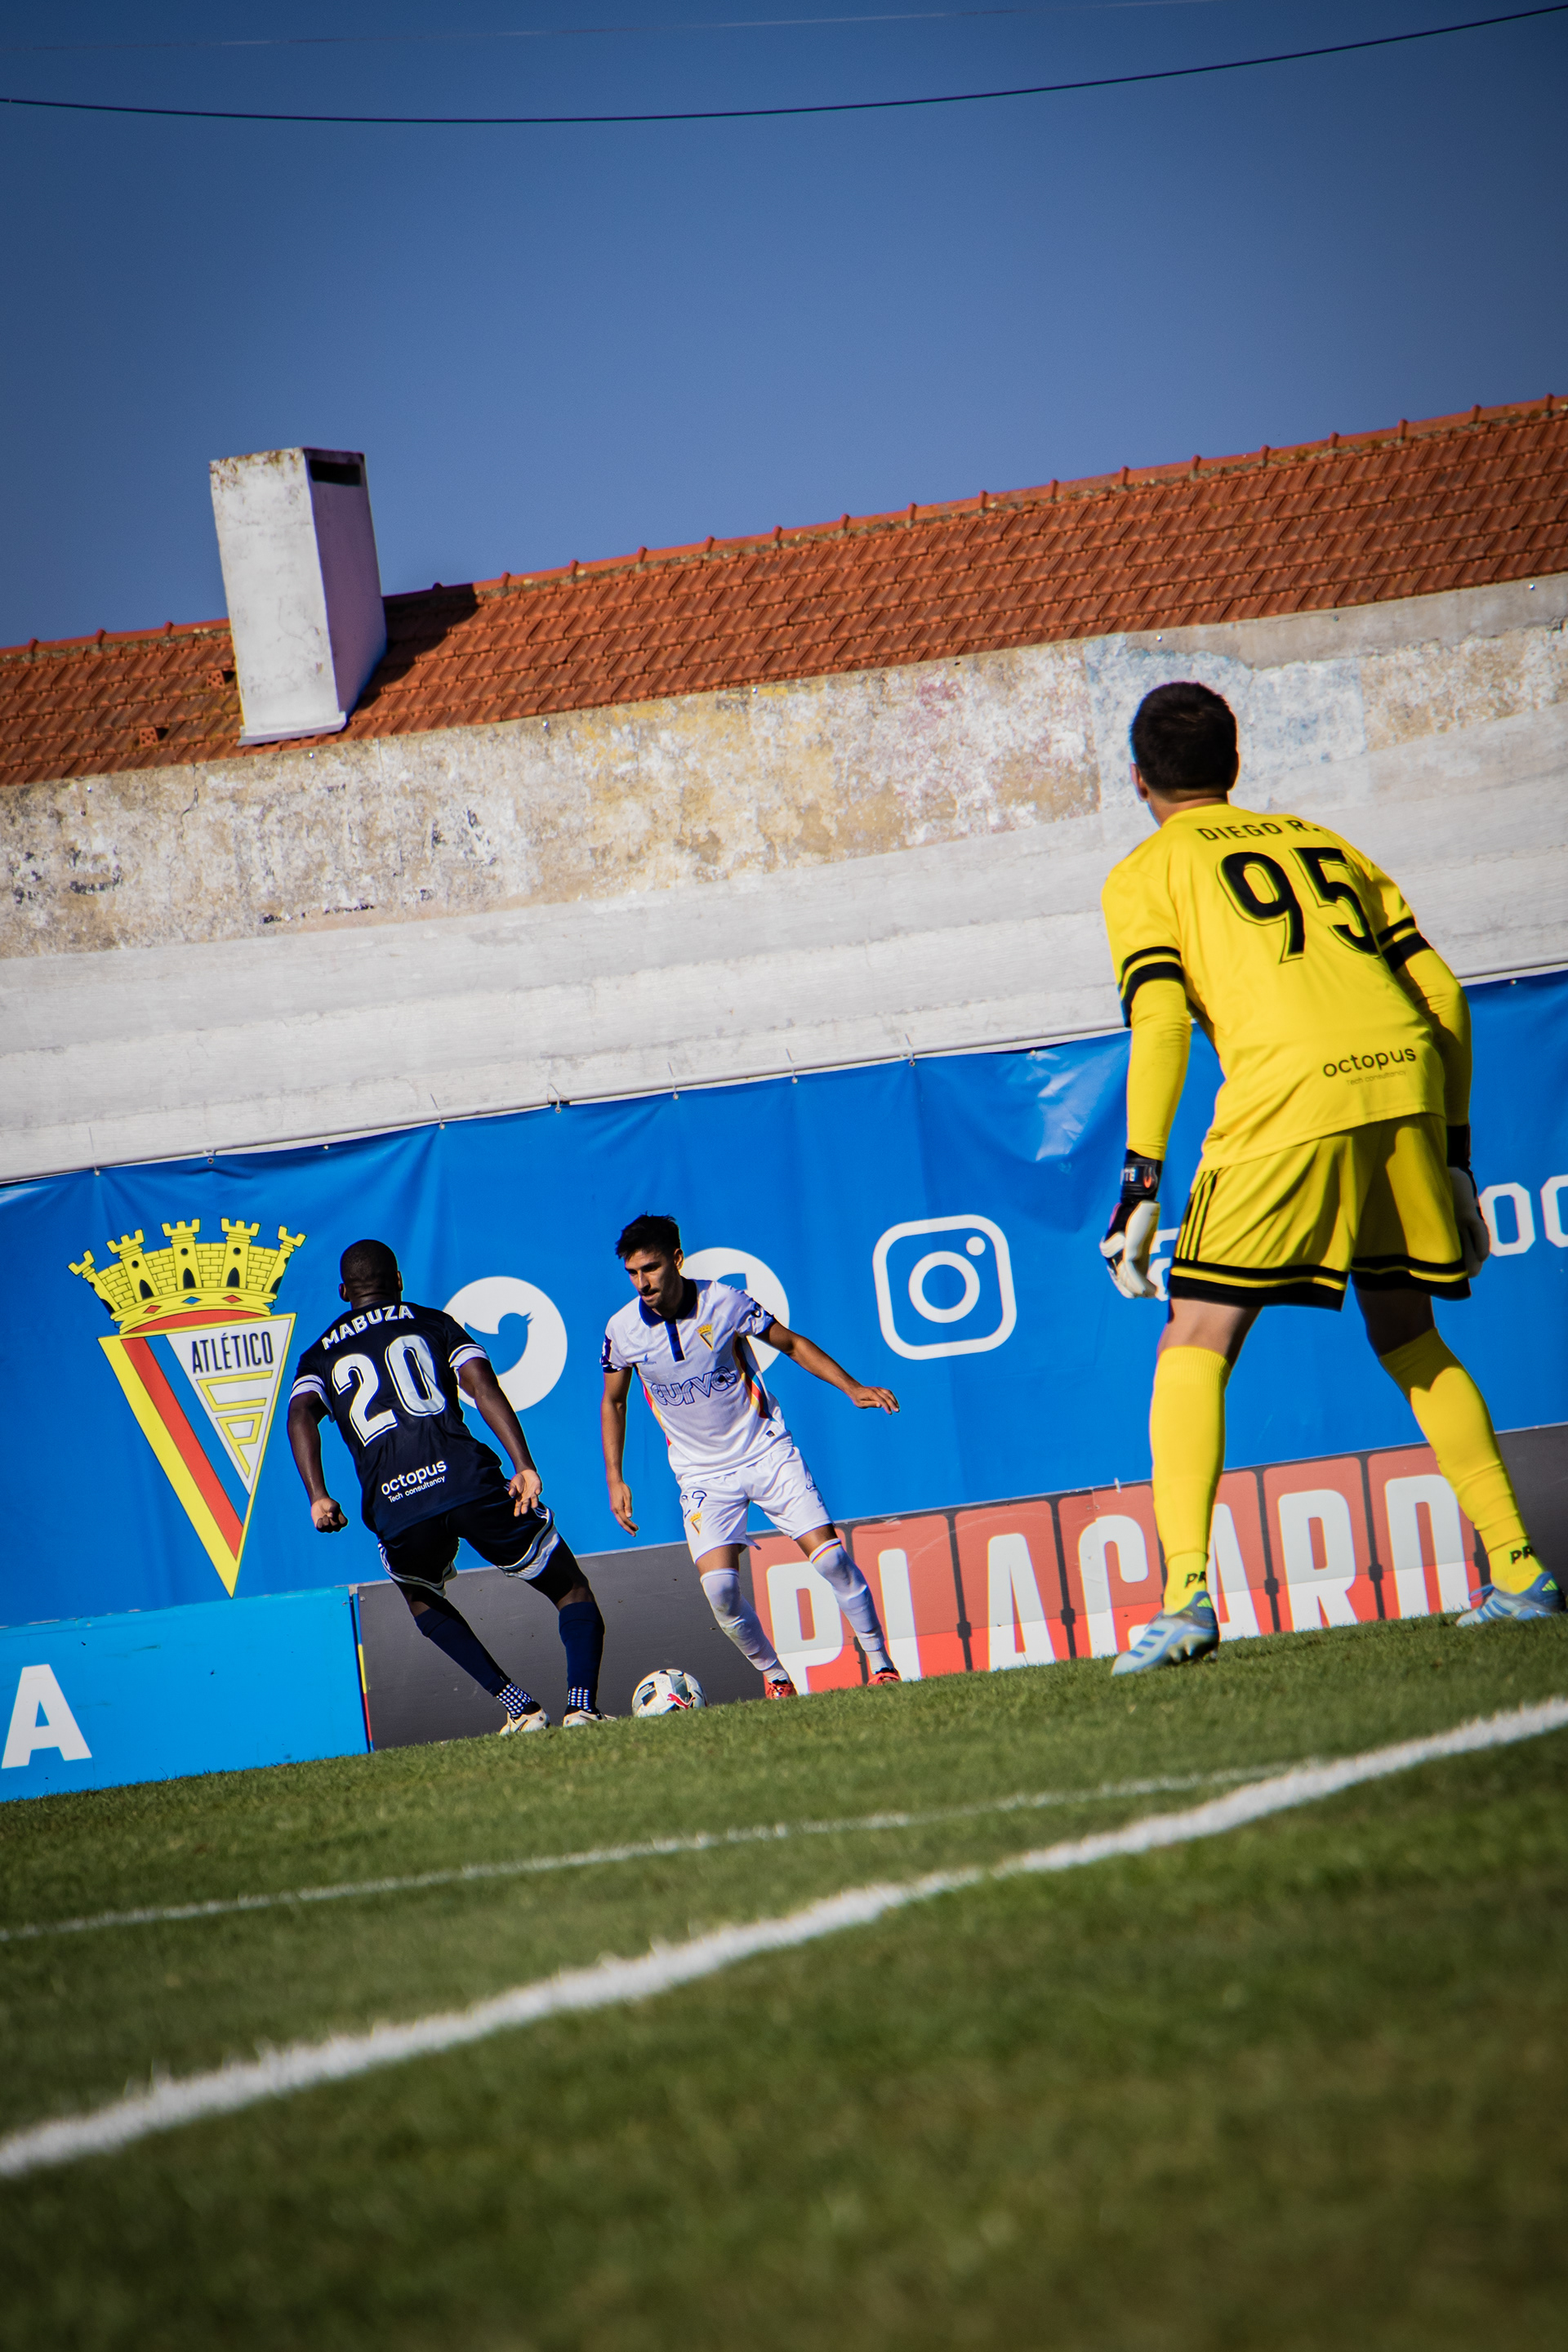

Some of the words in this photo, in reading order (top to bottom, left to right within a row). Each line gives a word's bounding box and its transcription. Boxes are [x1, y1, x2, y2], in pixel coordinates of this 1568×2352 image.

[1195, 822, 1283, 841] DIEGO
[1285, 819, 1321, 833] R.
[1215, 846, 1383, 965] 95
[1323, 1048, 1416, 1077] octopus
[321, 1304, 414, 1351] MABUZA
[191, 1331, 274, 1374] ATLÉTICO
[331, 1334, 446, 1447] 20
[381, 1459, 448, 1496] octopus
[387, 1491, 404, 1503] Tech
[404, 1475, 446, 1497] consultancy
[1, 1663, 93, 1770] A
